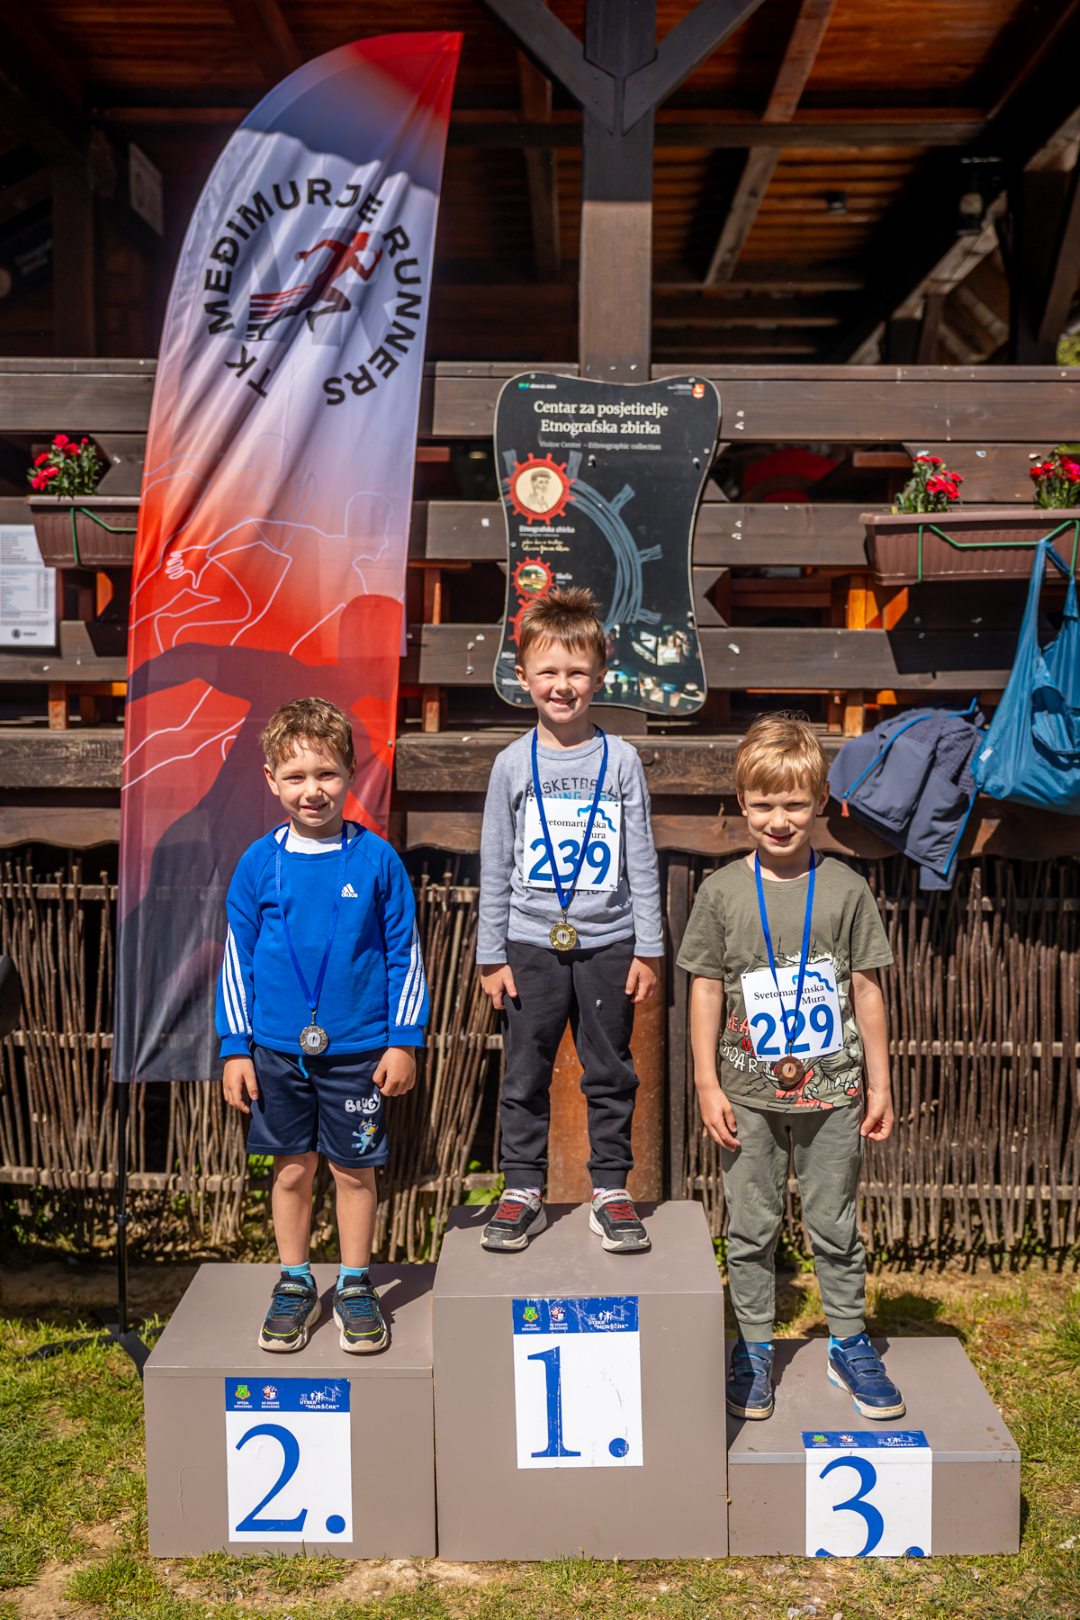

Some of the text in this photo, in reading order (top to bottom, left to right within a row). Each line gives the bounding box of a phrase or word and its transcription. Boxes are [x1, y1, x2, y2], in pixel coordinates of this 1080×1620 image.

[203, 178, 423, 406] TK MEĐIMURJE RUNNERS
[533, 400, 669, 419] Centar za posjetitelje
[541, 419, 661, 436] Etnografska zbirka
[588, 442, 630, 451] Ethnographic
[631, 442, 662, 450] collection
[528, 838, 611, 885] 239
[801, 995, 826, 1005] Mura
[750, 1004, 834, 1056] 229
[527, 1346, 629, 1458] 1.
[235, 1423, 346, 1535] 2.
